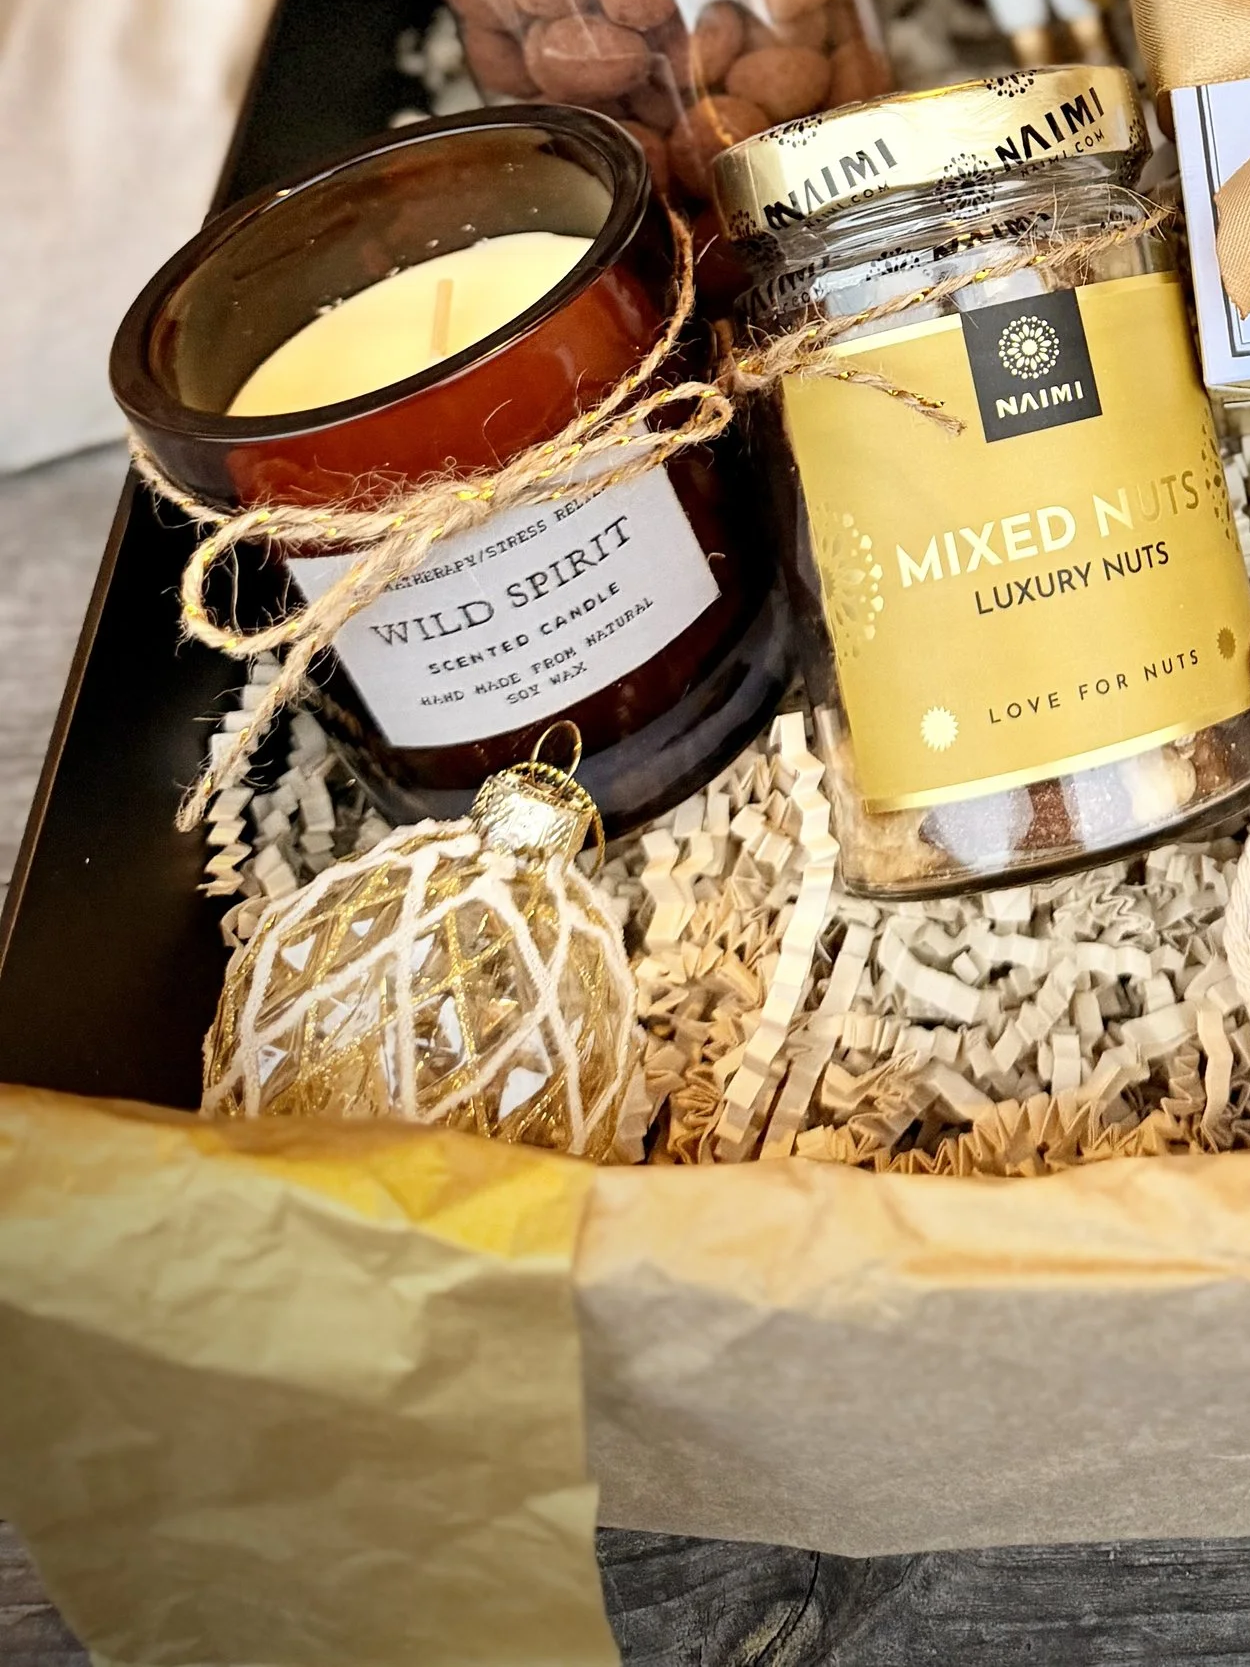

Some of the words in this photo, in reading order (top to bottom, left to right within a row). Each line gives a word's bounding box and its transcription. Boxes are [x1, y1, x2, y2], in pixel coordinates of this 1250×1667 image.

[995, 87, 1104, 172] NAIMI
[1021, 129, 1105, 178] NAIMI.COM
[995, 381, 1084, 419] NAIMI
[896, 505, 1077, 588] MIXED
[1093, 470, 1200, 538] NUTS
[369, 600, 495, 646] WILD
[506, 515, 631, 608] SPIRIT
[975, 562, 1093, 615] LUXURY
[1103, 541, 1170, 582] NUTS
[421, 689, 464, 706] HAND
[475, 673, 521, 694] MADE
[530, 647, 577, 674] FROM
[585, 597, 654, 647] NATURAL
[428, 634, 529, 675] SCENTED
[540, 582, 621, 635] CANDLE
[506, 684, 541, 704] SOY
[549, 661, 587, 685] WAX
[989, 692, 1061, 724] LOVE
[1079, 673, 1129, 702] FOR
[1144, 649, 1200, 679] NUTS
